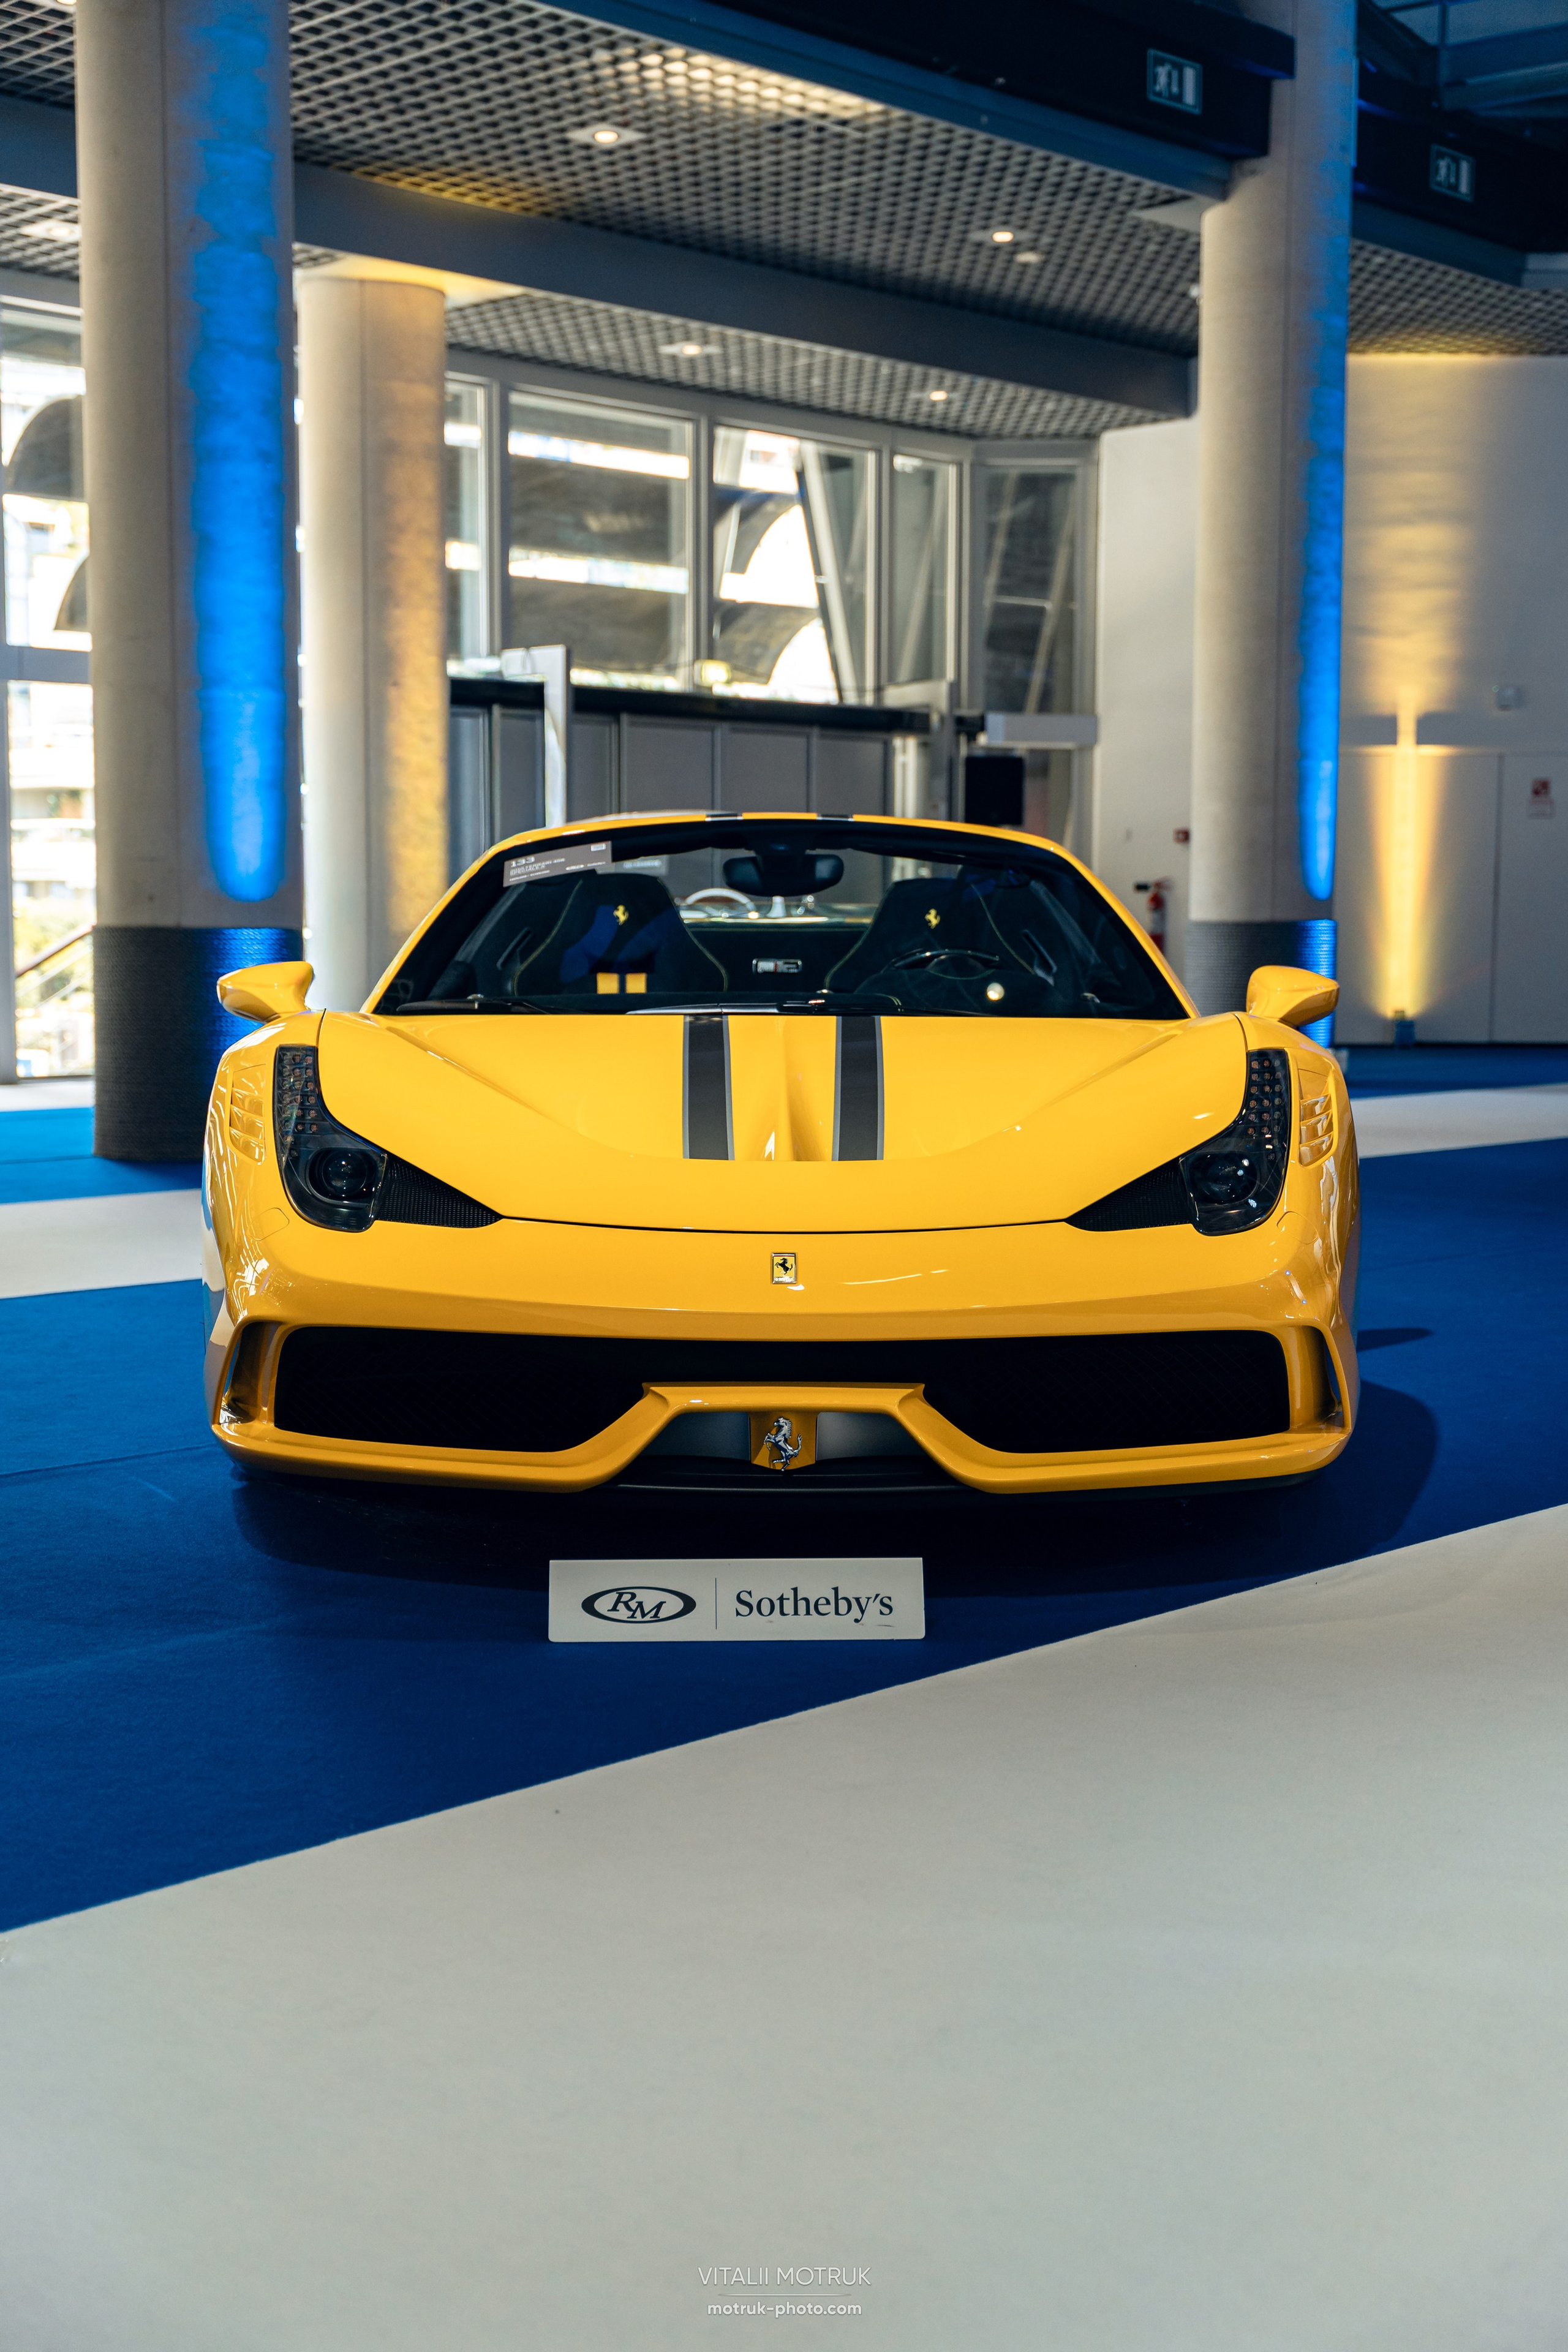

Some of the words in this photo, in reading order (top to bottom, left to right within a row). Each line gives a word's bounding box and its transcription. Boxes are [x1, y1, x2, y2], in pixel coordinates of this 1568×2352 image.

[510, 856, 535, 868] 133
[606, 1591, 667, 1620] RM
[735, 1586, 894, 1624] Sotheby's
